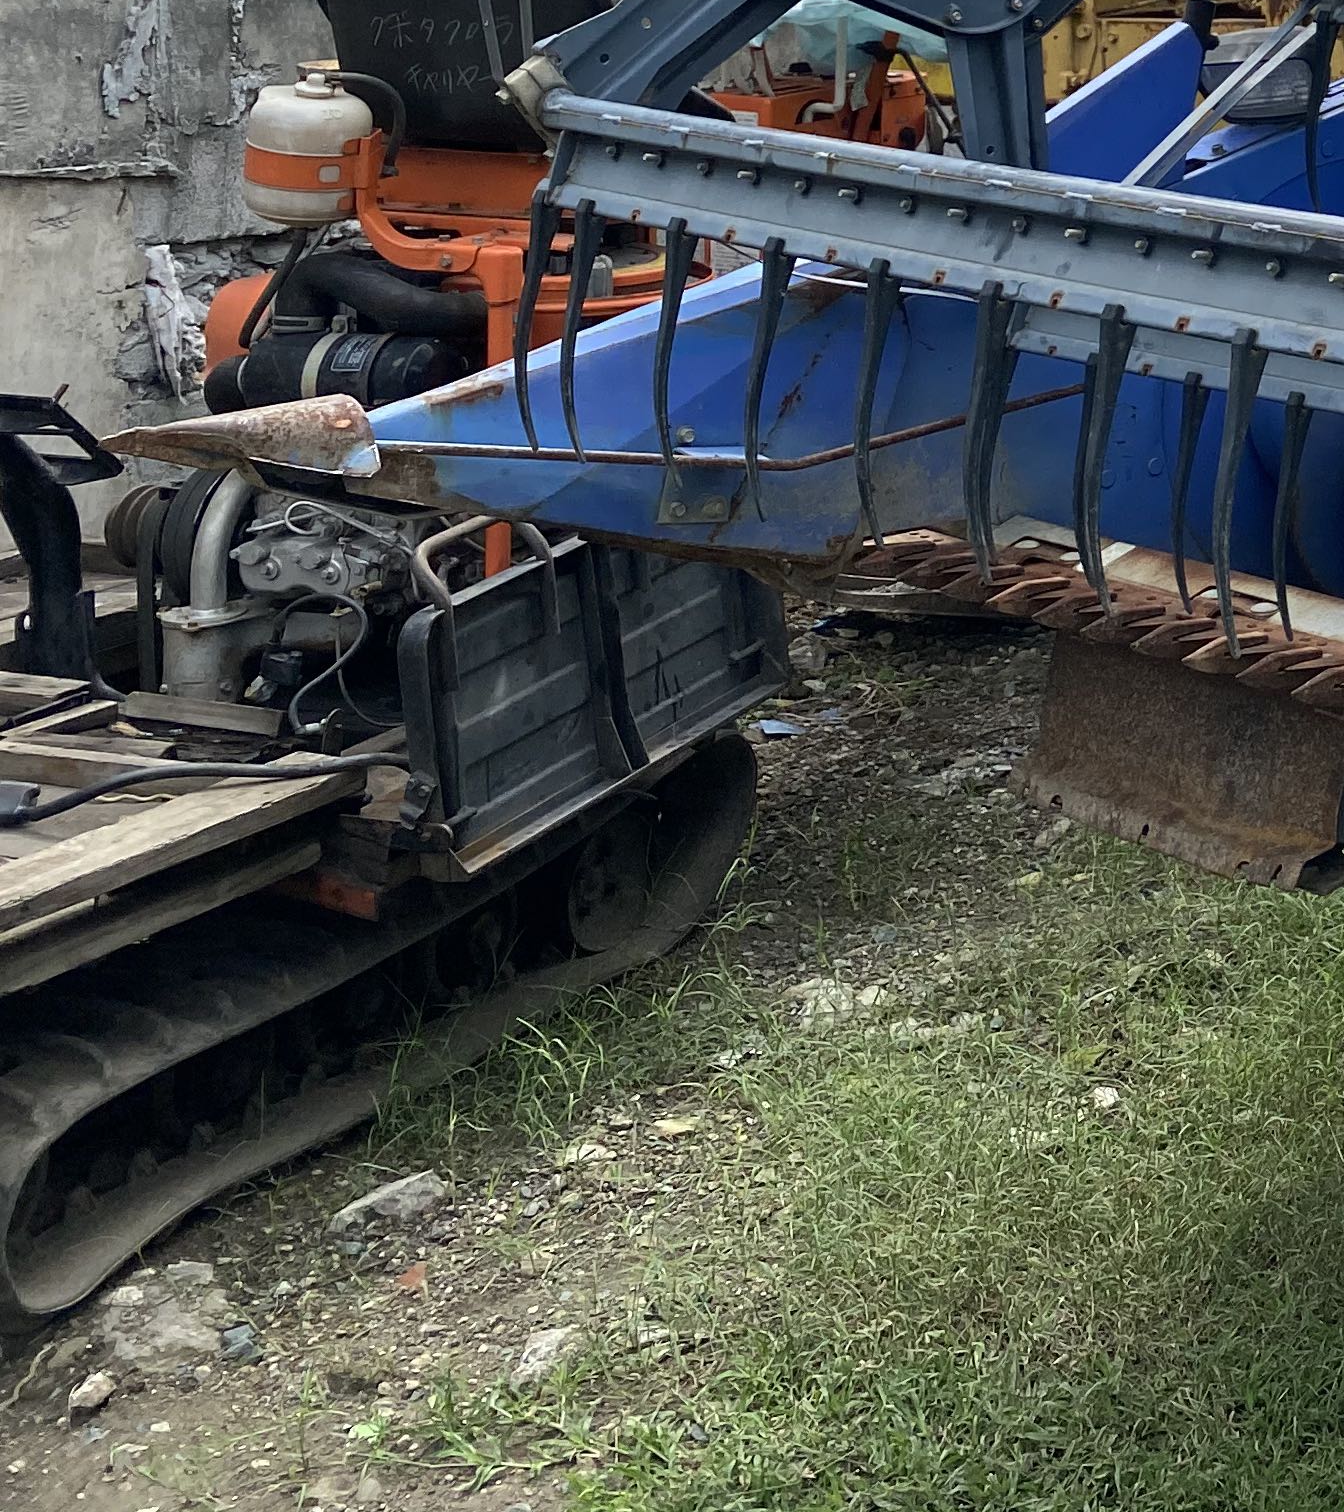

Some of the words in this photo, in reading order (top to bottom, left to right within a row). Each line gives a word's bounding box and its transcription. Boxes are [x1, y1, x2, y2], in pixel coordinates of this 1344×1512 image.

[370, 9, 514, 49] クボタクロラ
